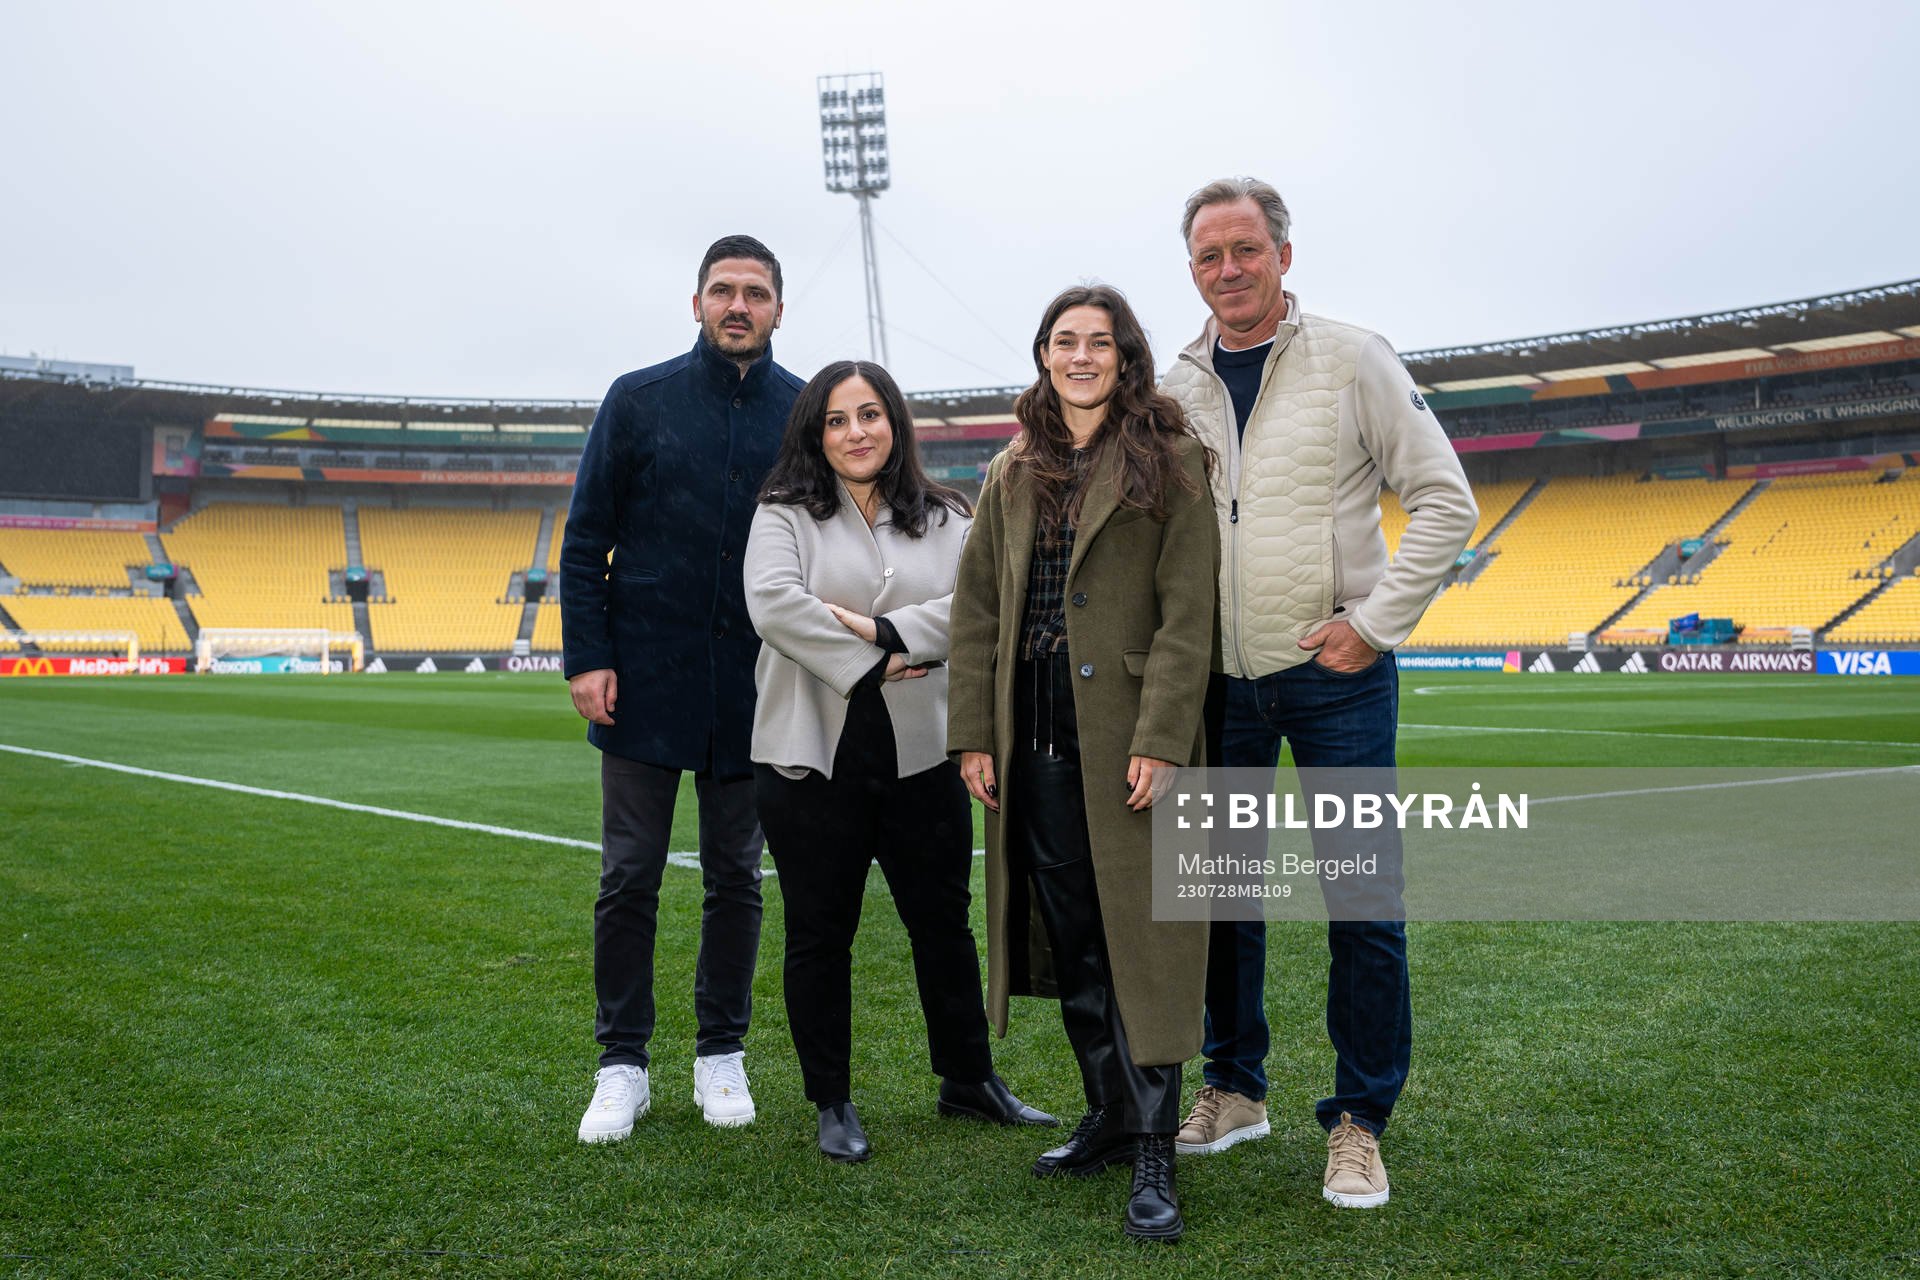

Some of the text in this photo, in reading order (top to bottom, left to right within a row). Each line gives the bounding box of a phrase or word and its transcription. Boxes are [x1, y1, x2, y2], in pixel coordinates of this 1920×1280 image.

[1744, 360, 1776, 374] FIFA
[1847, 344, 1899, 362] WORLD
[1715, 409, 1805, 430] WELLINGTON
[1815, 407, 1833, 420] TE
[69, 658, 170, 674] McDonld's
[507, 656, 561, 672] QATAR
[1661, 652, 1812, 672] QATAR AIRWAYS
[1828, 652, 1892, 675] VISA
